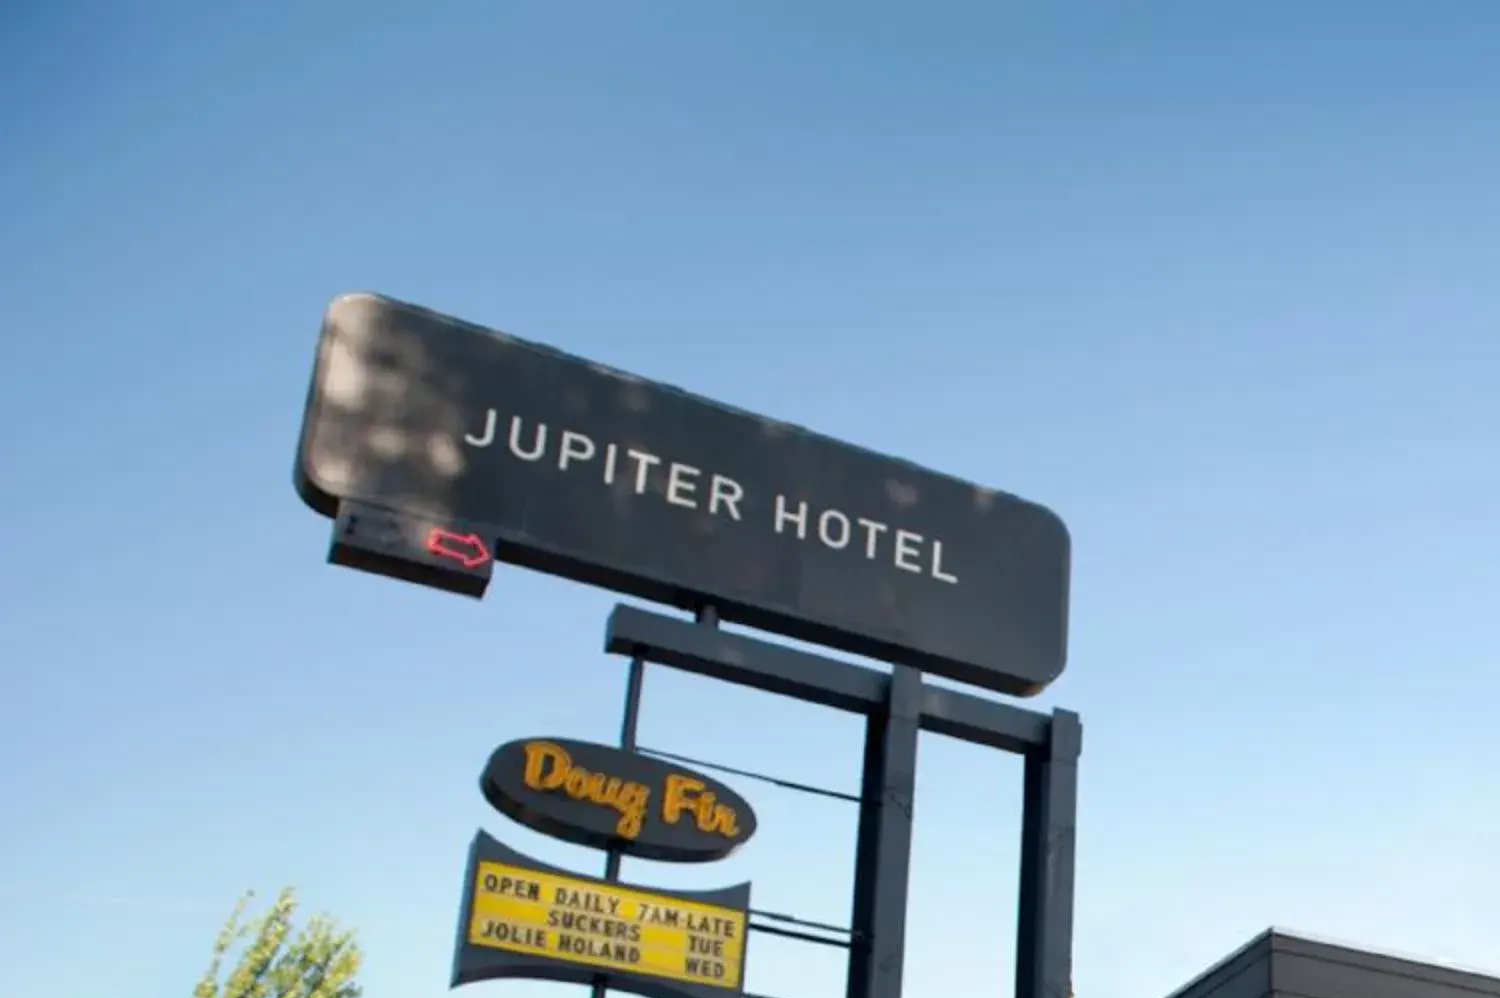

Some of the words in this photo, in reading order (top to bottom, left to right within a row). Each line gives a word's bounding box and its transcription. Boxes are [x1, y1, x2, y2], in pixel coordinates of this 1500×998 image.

[465, 409, 743, 520] JUPITER
[775, 495, 958, 584] HOTEL
[524, 741, 651, 840] Doug
[485, 873, 540, 900] OPEN
[556, 887, 620, 914] DAILY
[482, 920, 546, 947] JOLIE
[557, 934, 640, 963] HOLAND
[685, 957, 725, 978] WED
[548, 909, 640, 941] SUCKERS
[689, 935, 724, 957] TUE
